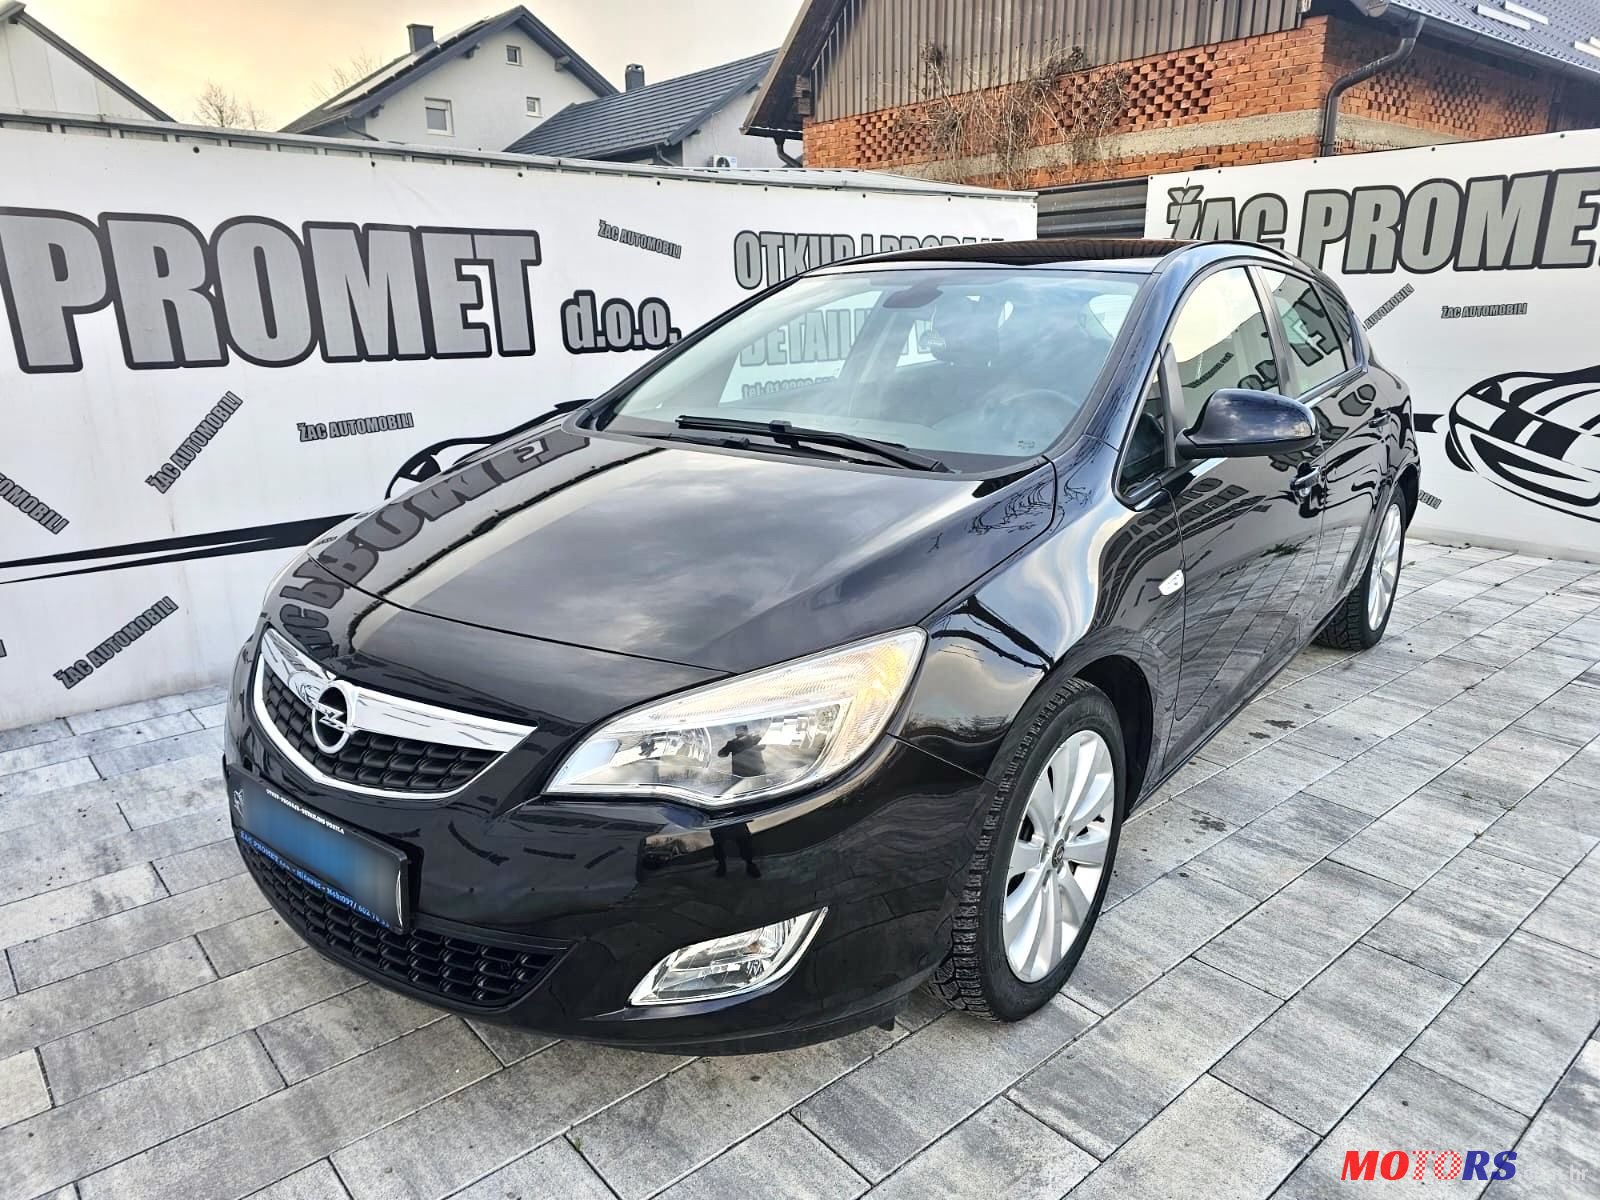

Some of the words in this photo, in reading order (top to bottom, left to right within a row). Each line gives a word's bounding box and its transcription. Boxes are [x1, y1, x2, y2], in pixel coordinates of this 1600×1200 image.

[598, 219, 620, 241] ŽAC
[619, 228, 682, 260] AUTOMOBILI
[1297, 166, 1600, 274] PROME
[0, 206, 541, 374] PROMET
[560, 290, 682, 354] d.o.o.
[1363, 282, 1415, 330] AUTOMOBILI
[1441, 305, 1461, 319] ŽAC
[1461, 303, 1528, 318] AUTOMOBILI
[145, 462, 181, 494] ŽAC
[169, 390, 243, 471] AUTOMOBILI
[296, 422, 328, 442] ŽAC
[329, 412, 414, 438] AUTOMOBILI
[0, 472, 70, 535] OMOBILI
[53, 659, 94, 690] ŽAC
[86, 595, 179, 669] AUTOMOBILI
